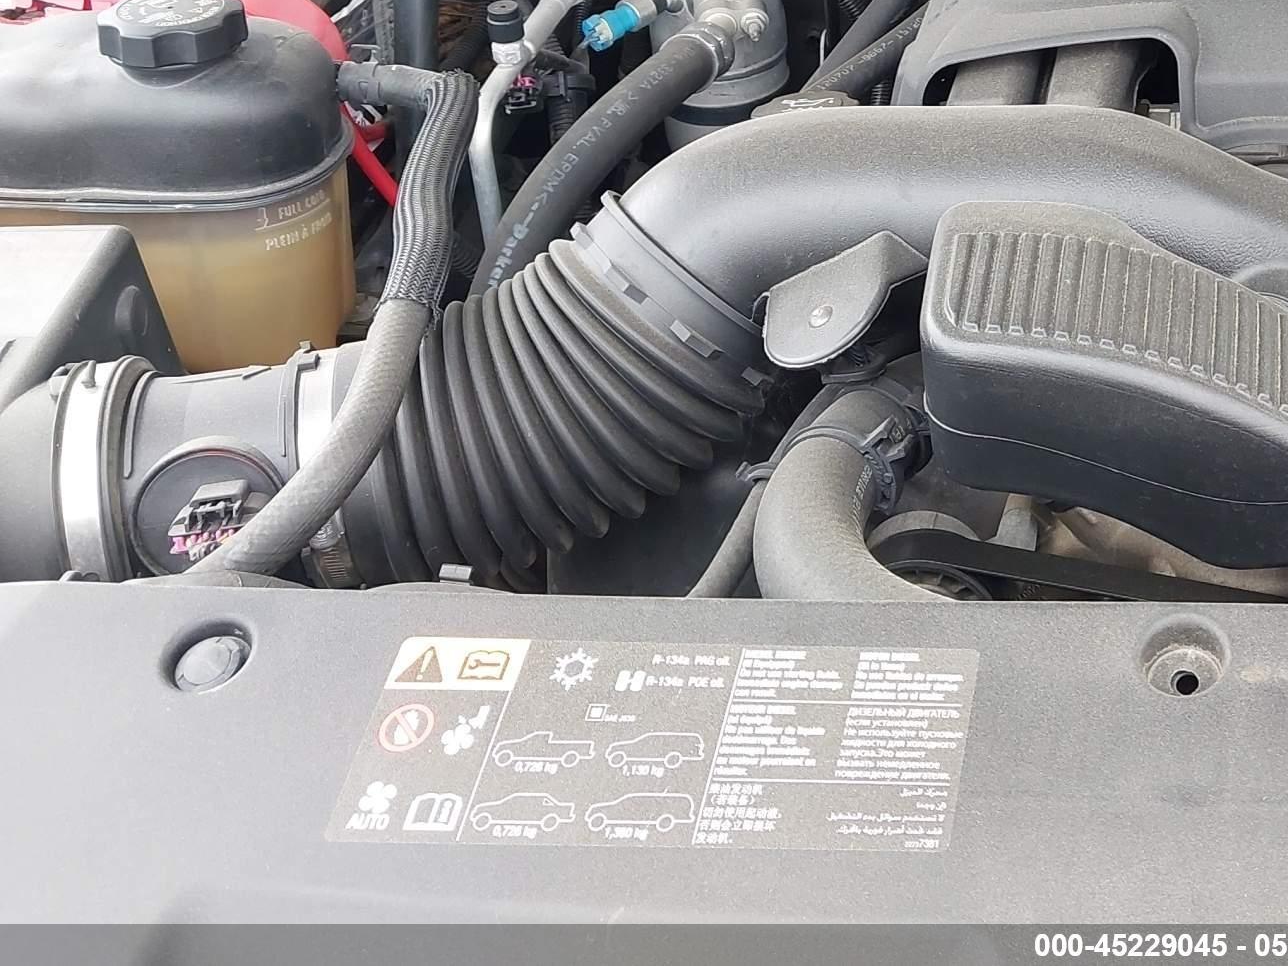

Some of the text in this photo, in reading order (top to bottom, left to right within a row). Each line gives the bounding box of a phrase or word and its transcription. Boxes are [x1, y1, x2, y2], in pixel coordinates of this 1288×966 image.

[278, 201, 303, 220] FULL
[265, 231, 300, 251] PLEIN
[345, 813, 390, 830] AUTO
